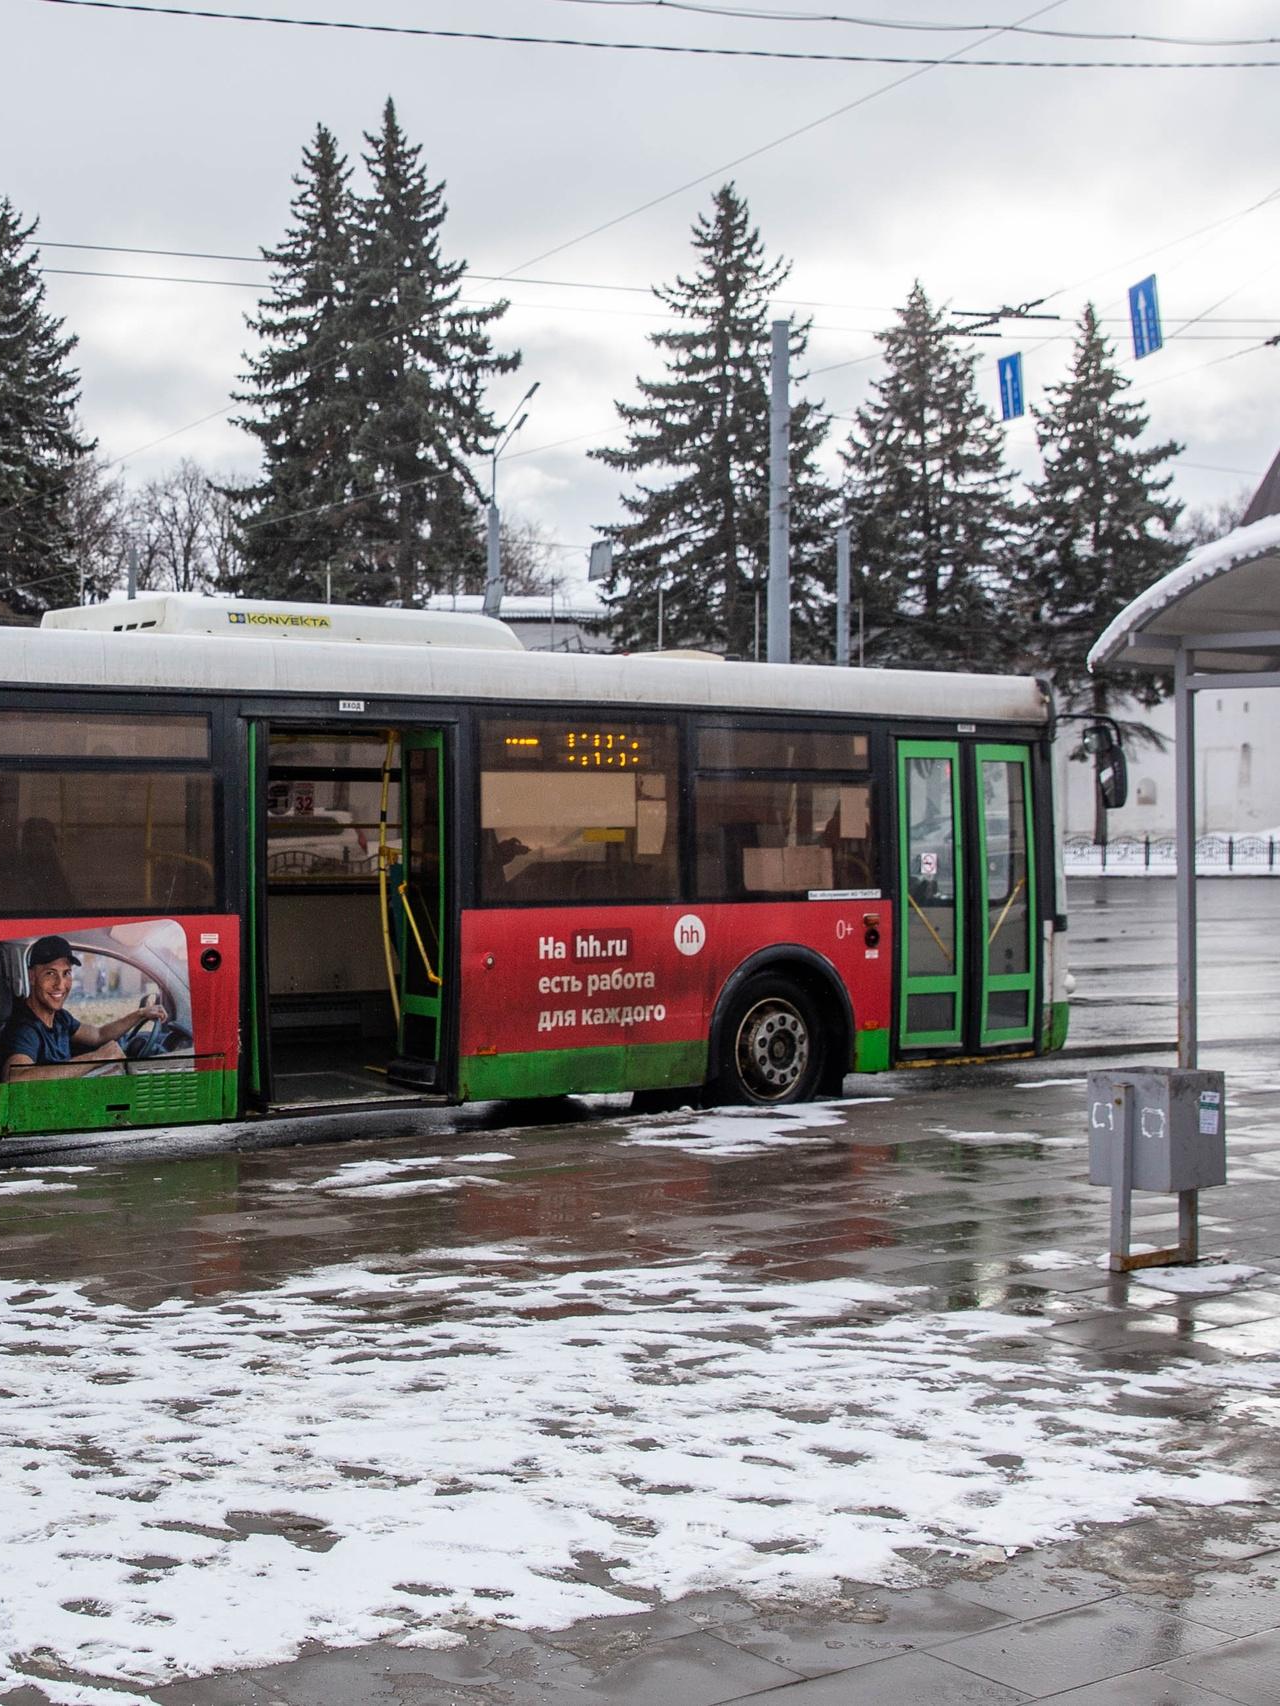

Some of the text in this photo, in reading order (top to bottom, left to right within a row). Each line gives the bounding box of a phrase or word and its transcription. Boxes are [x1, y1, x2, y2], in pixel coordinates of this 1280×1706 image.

[247, 613, 329, 627] KONVEKTA
[295, 796, 313, 810] 32
[680, 925, 699, 944] hh
[836, 919, 854, 940] 0+
[538, 935, 627, 960] На hh.ru
[538, 967, 655, 997] есть работа
[537, 1003, 666, 1032] для каждого
